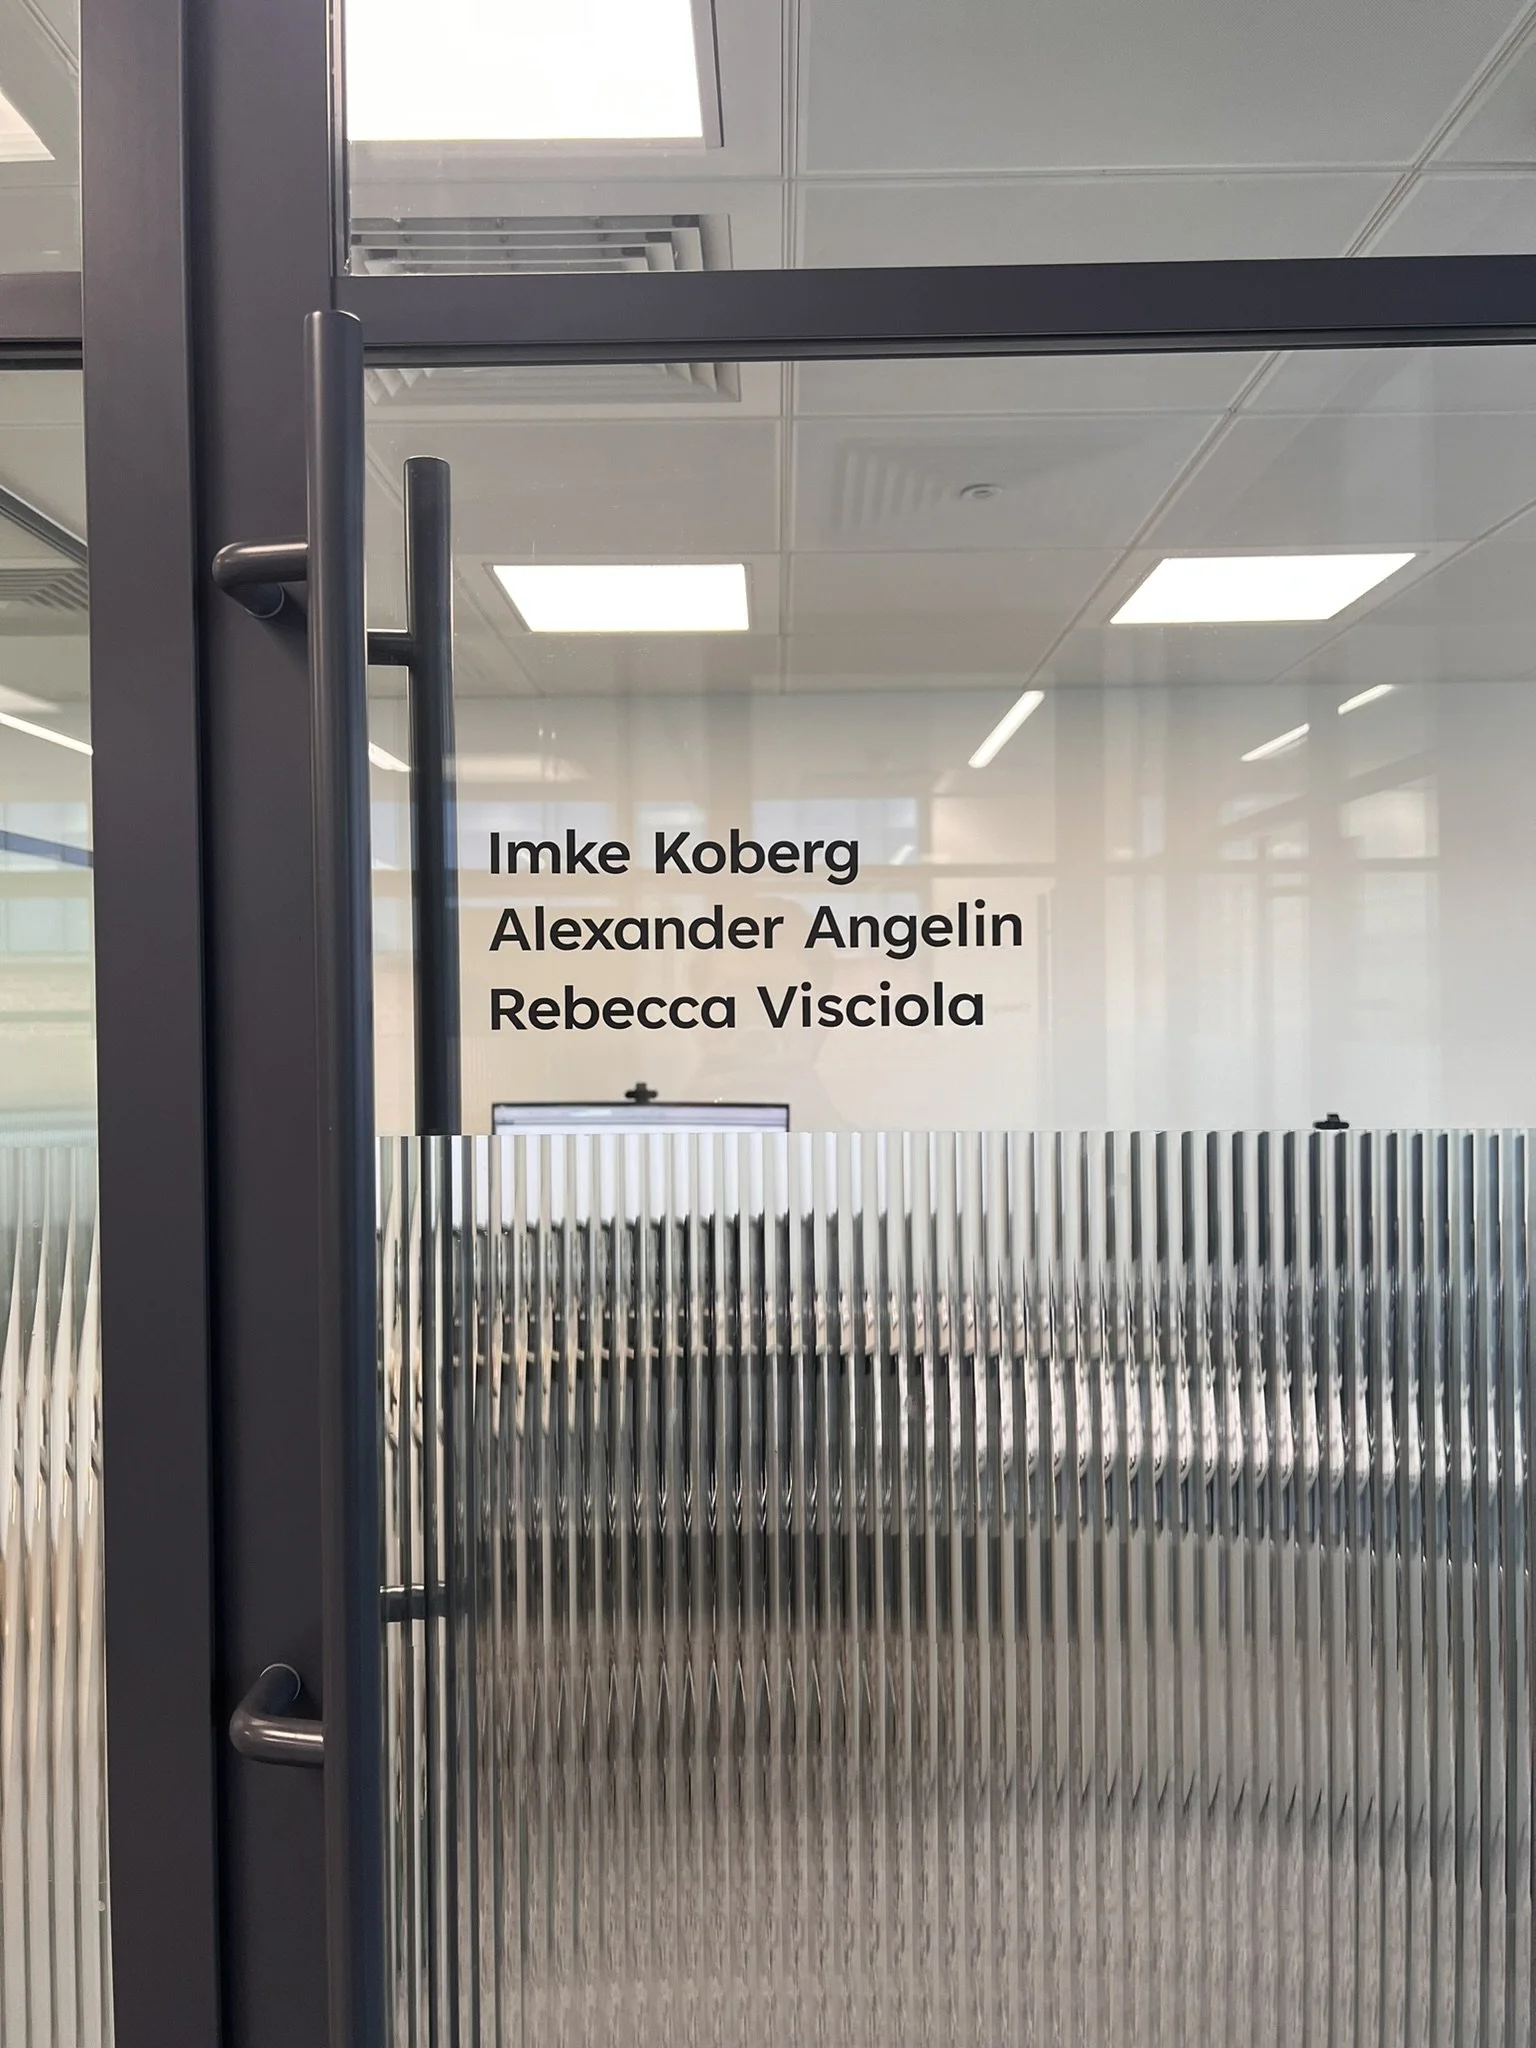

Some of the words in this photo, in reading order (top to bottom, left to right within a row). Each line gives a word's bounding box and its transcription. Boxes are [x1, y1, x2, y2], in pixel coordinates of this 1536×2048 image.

[490, 828, 631, 875] Imke
[655, 828, 860, 886] Koberg
[489, 904, 785, 951] Alexander
[804, 898, 1023, 960] Angelin
[490, 985, 736, 1031] Rebecca
[756, 980, 984, 1029] Visciola
